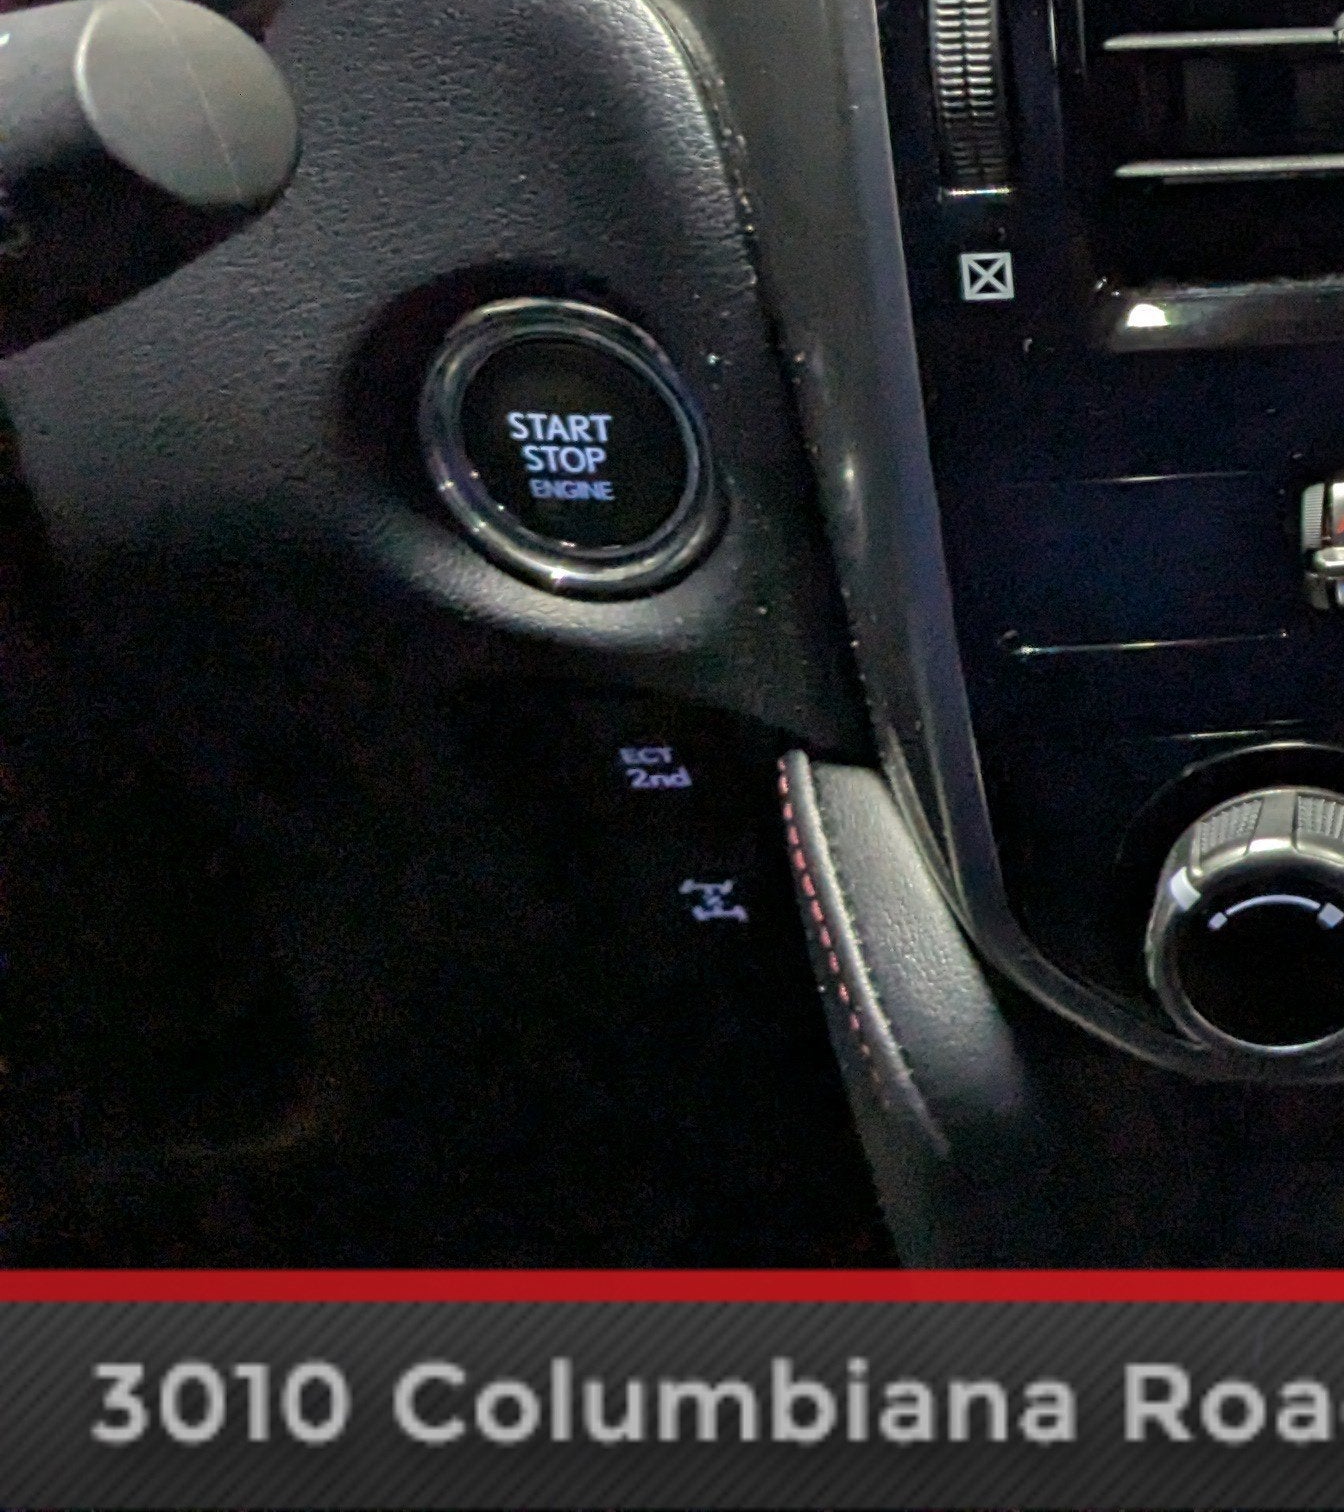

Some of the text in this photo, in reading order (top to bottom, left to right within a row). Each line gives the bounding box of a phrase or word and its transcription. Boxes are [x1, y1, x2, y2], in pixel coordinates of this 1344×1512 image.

[507, 411, 612, 443] START
[522, 445, 606, 475] STOP
[529, 479, 614, 501] ENGINE
[619, 746, 672, 766] ECT
[629, 766, 692, 788] 2nd
